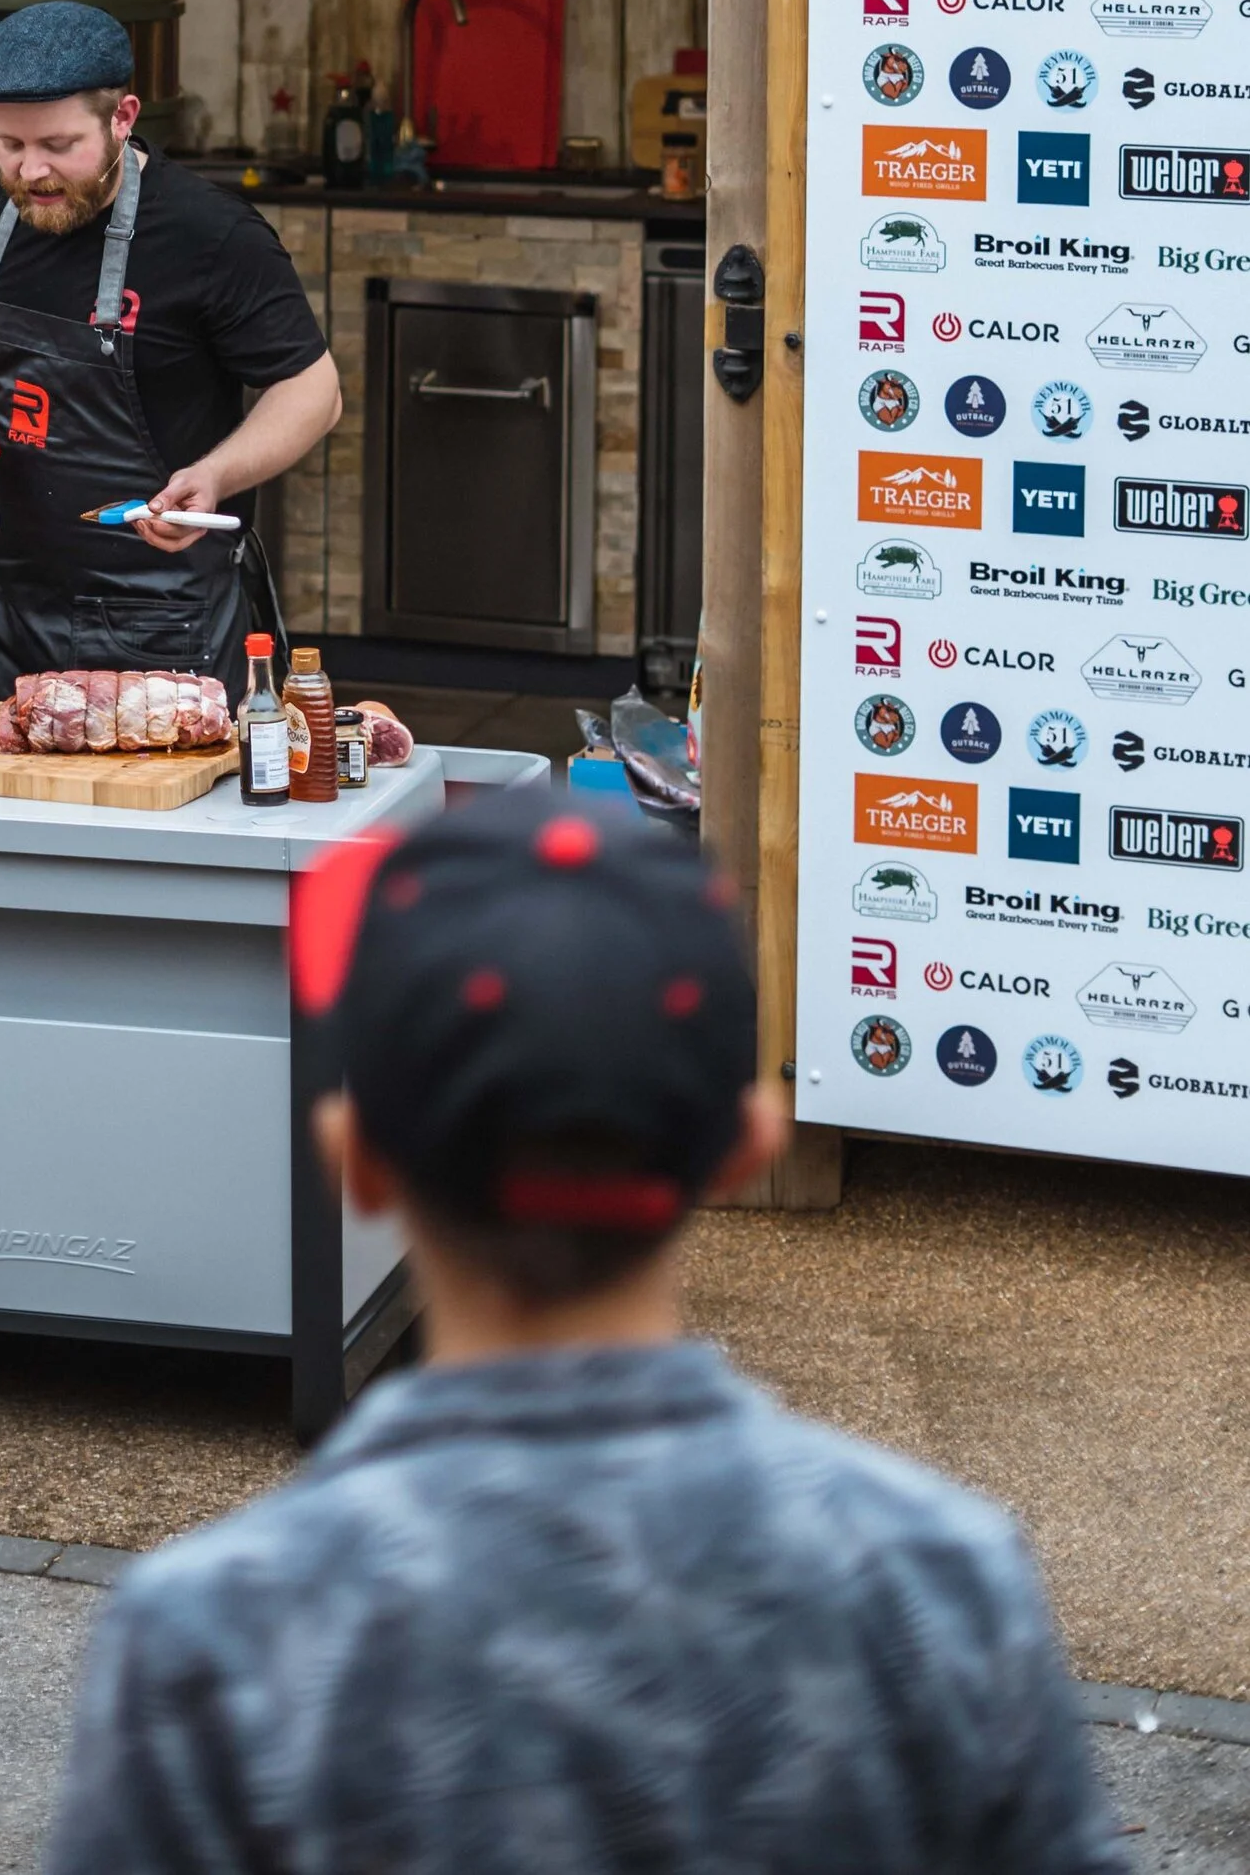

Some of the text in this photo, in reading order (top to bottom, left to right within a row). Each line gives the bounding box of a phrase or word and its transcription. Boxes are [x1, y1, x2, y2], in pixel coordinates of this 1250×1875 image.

[863, 16, 909, 27] RAPS
[1039, 51, 1096, 81] WEYMOUTH
[1056, 67, 1077, 85] 51
[960, 84, 1000, 95] OUTBACK
[874, 161, 976, 182] TRAEGER
[1026, 158, 1081, 179] YETI
[1130, 150, 1219, 194] weber
[974, 233, 1130, 264] Broil King
[1158, 245, 1250, 275] Big Gre
[975, 257, 1129, 275] Great Barbecues Every Time
[968, 319, 1060, 343] CALOR
[859, 341, 905, 353] RAPS
[1034, 382, 1091, 412] WEYMOUTH
[1051, 397, 1072, 415] 51
[1158, 415, 1250, 434] GLOBALT
[8, 429, 46, 449] RAPS
[870, 486, 971, 511] TRAEGER
[1021, 488, 1076, 510] YETI
[1125, 483, 1215, 529] weber
[970, 561, 1125, 595] Broil King
[970, 585, 1124, 606] Great Barbecues Every Time
[1152, 578, 1250, 608] Big Gre
[964, 646, 1055, 672] CALOR
[855, 666, 901, 678] RAPS
[1029, 710, 1087, 742] WEYMOUTH
[1046, 726, 1067, 744] 51
[866, 808, 967, 835] TRAEGER
[1016, 814, 1072, 837] YETI
[1120, 813, 1209, 859] weber
[965, 886, 1120, 923] Broil King
[966, 910, 1119, 934] Great Barbecues Every Time
[1147, 907, 1189, 938] Big
[851, 986, 897, 1000] RAPS
[960, 970, 1050, 998] CALOR
[1024, 1036, 1082, 1068] WEYMOUTH
[1149, 1074, 1250, 1099] GLOBALTI
